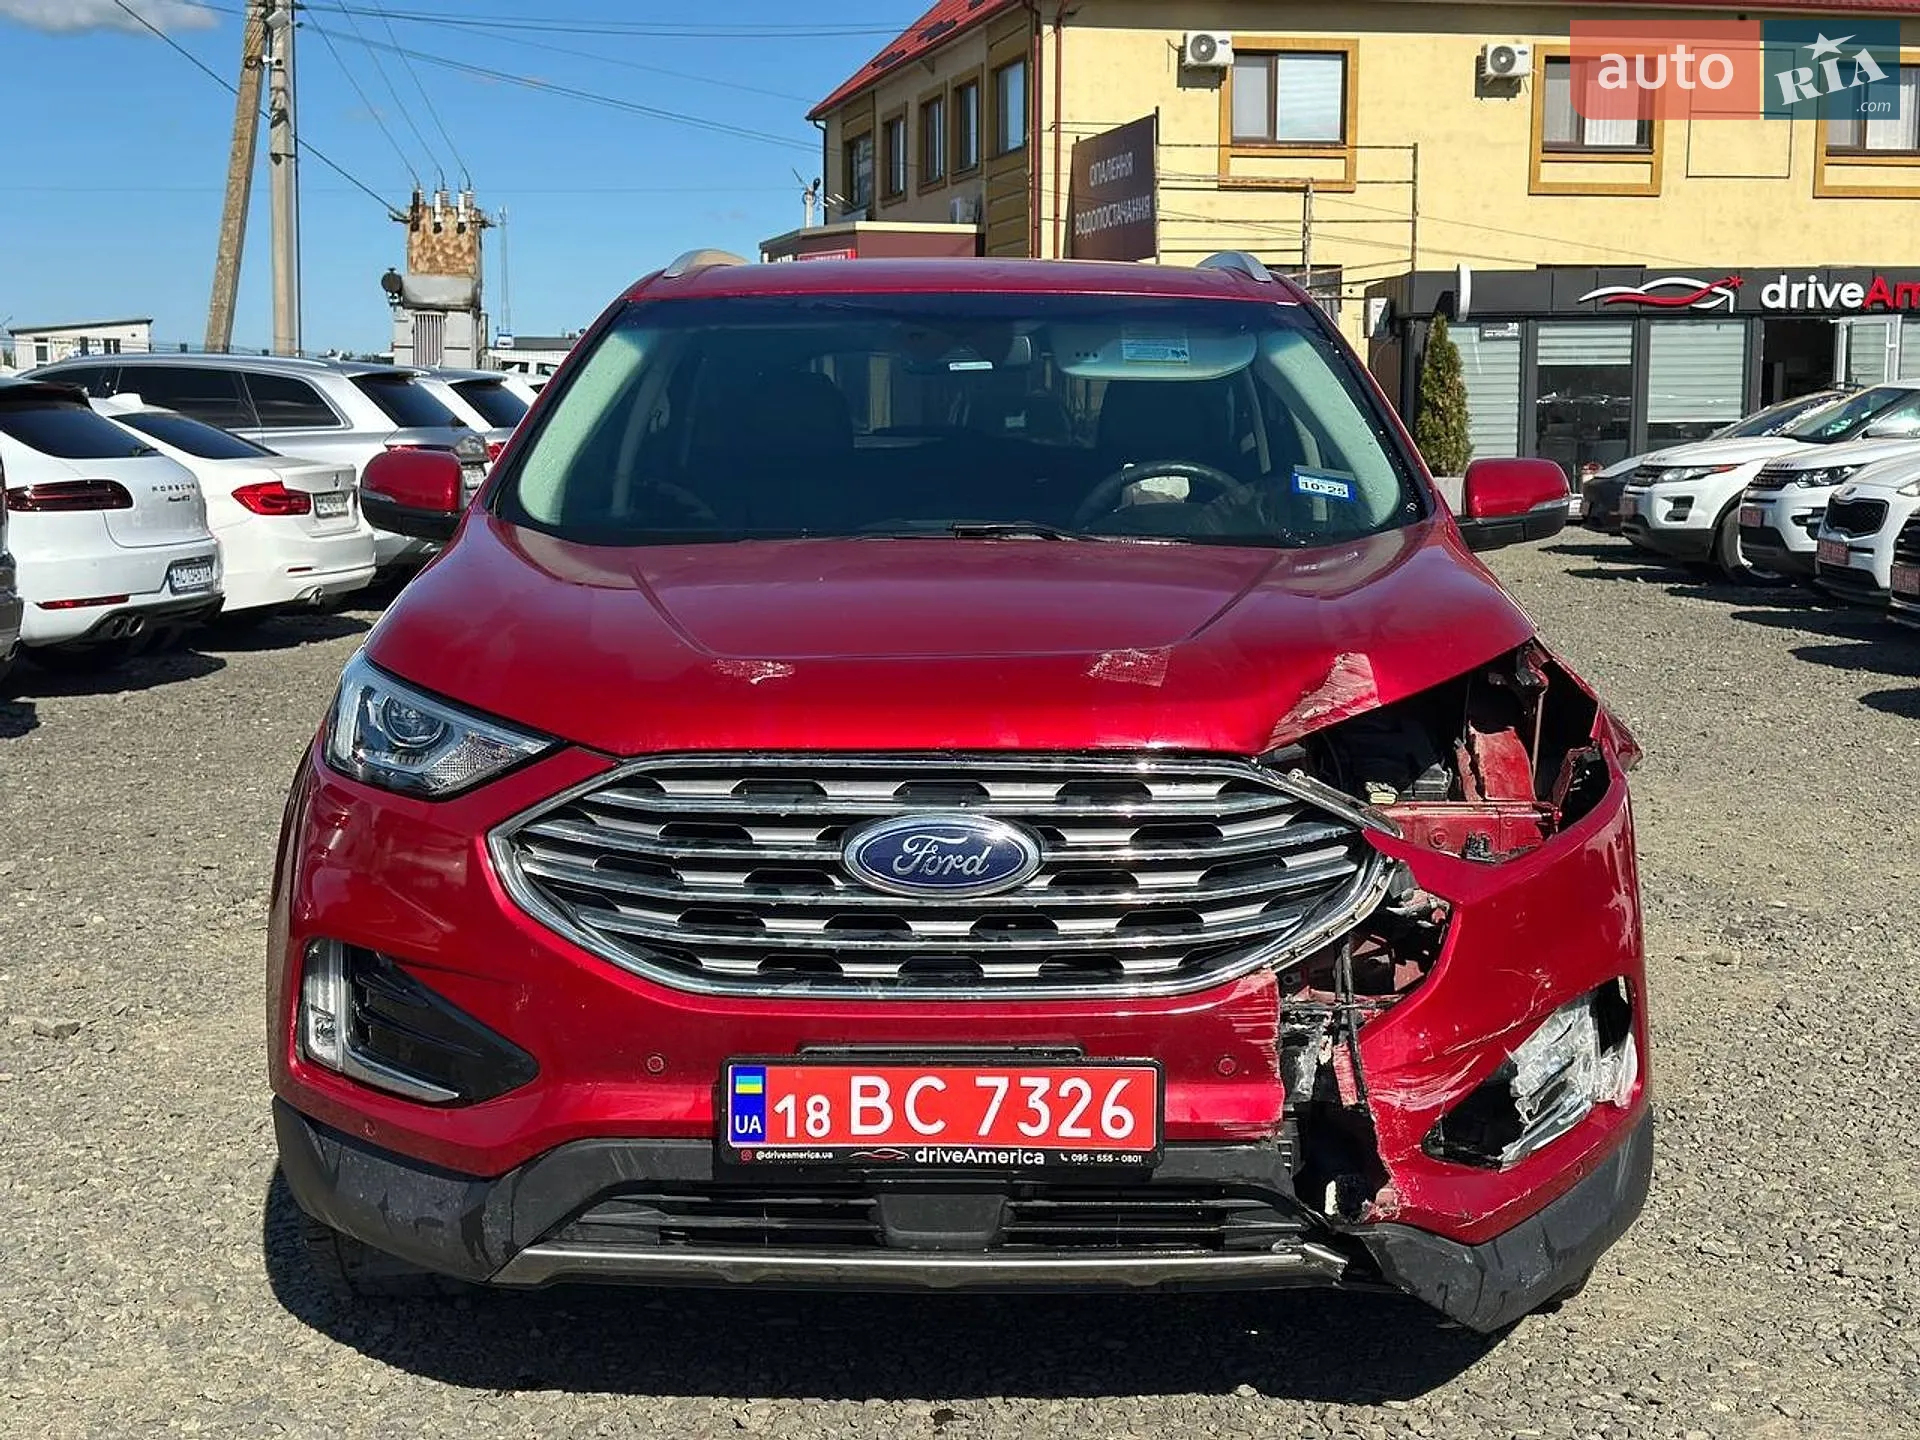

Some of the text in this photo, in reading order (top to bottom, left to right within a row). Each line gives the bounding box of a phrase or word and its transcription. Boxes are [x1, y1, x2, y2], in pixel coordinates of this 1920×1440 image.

[1088, 151, 1134, 188] ОПАЛЕННЯ
[1075, 194, 1151, 238] ВОДОПОСТАЧАННЯ
[892, 834, 993, 876] Ford
[735, 1114, 762, 1134] UA
[773, 1075, 1134, 1139] 18 BC 7326
[756, 1150, 834, 1161] @driveamerica.ua
[914, 1147, 1045, 1165] driveAmerica
